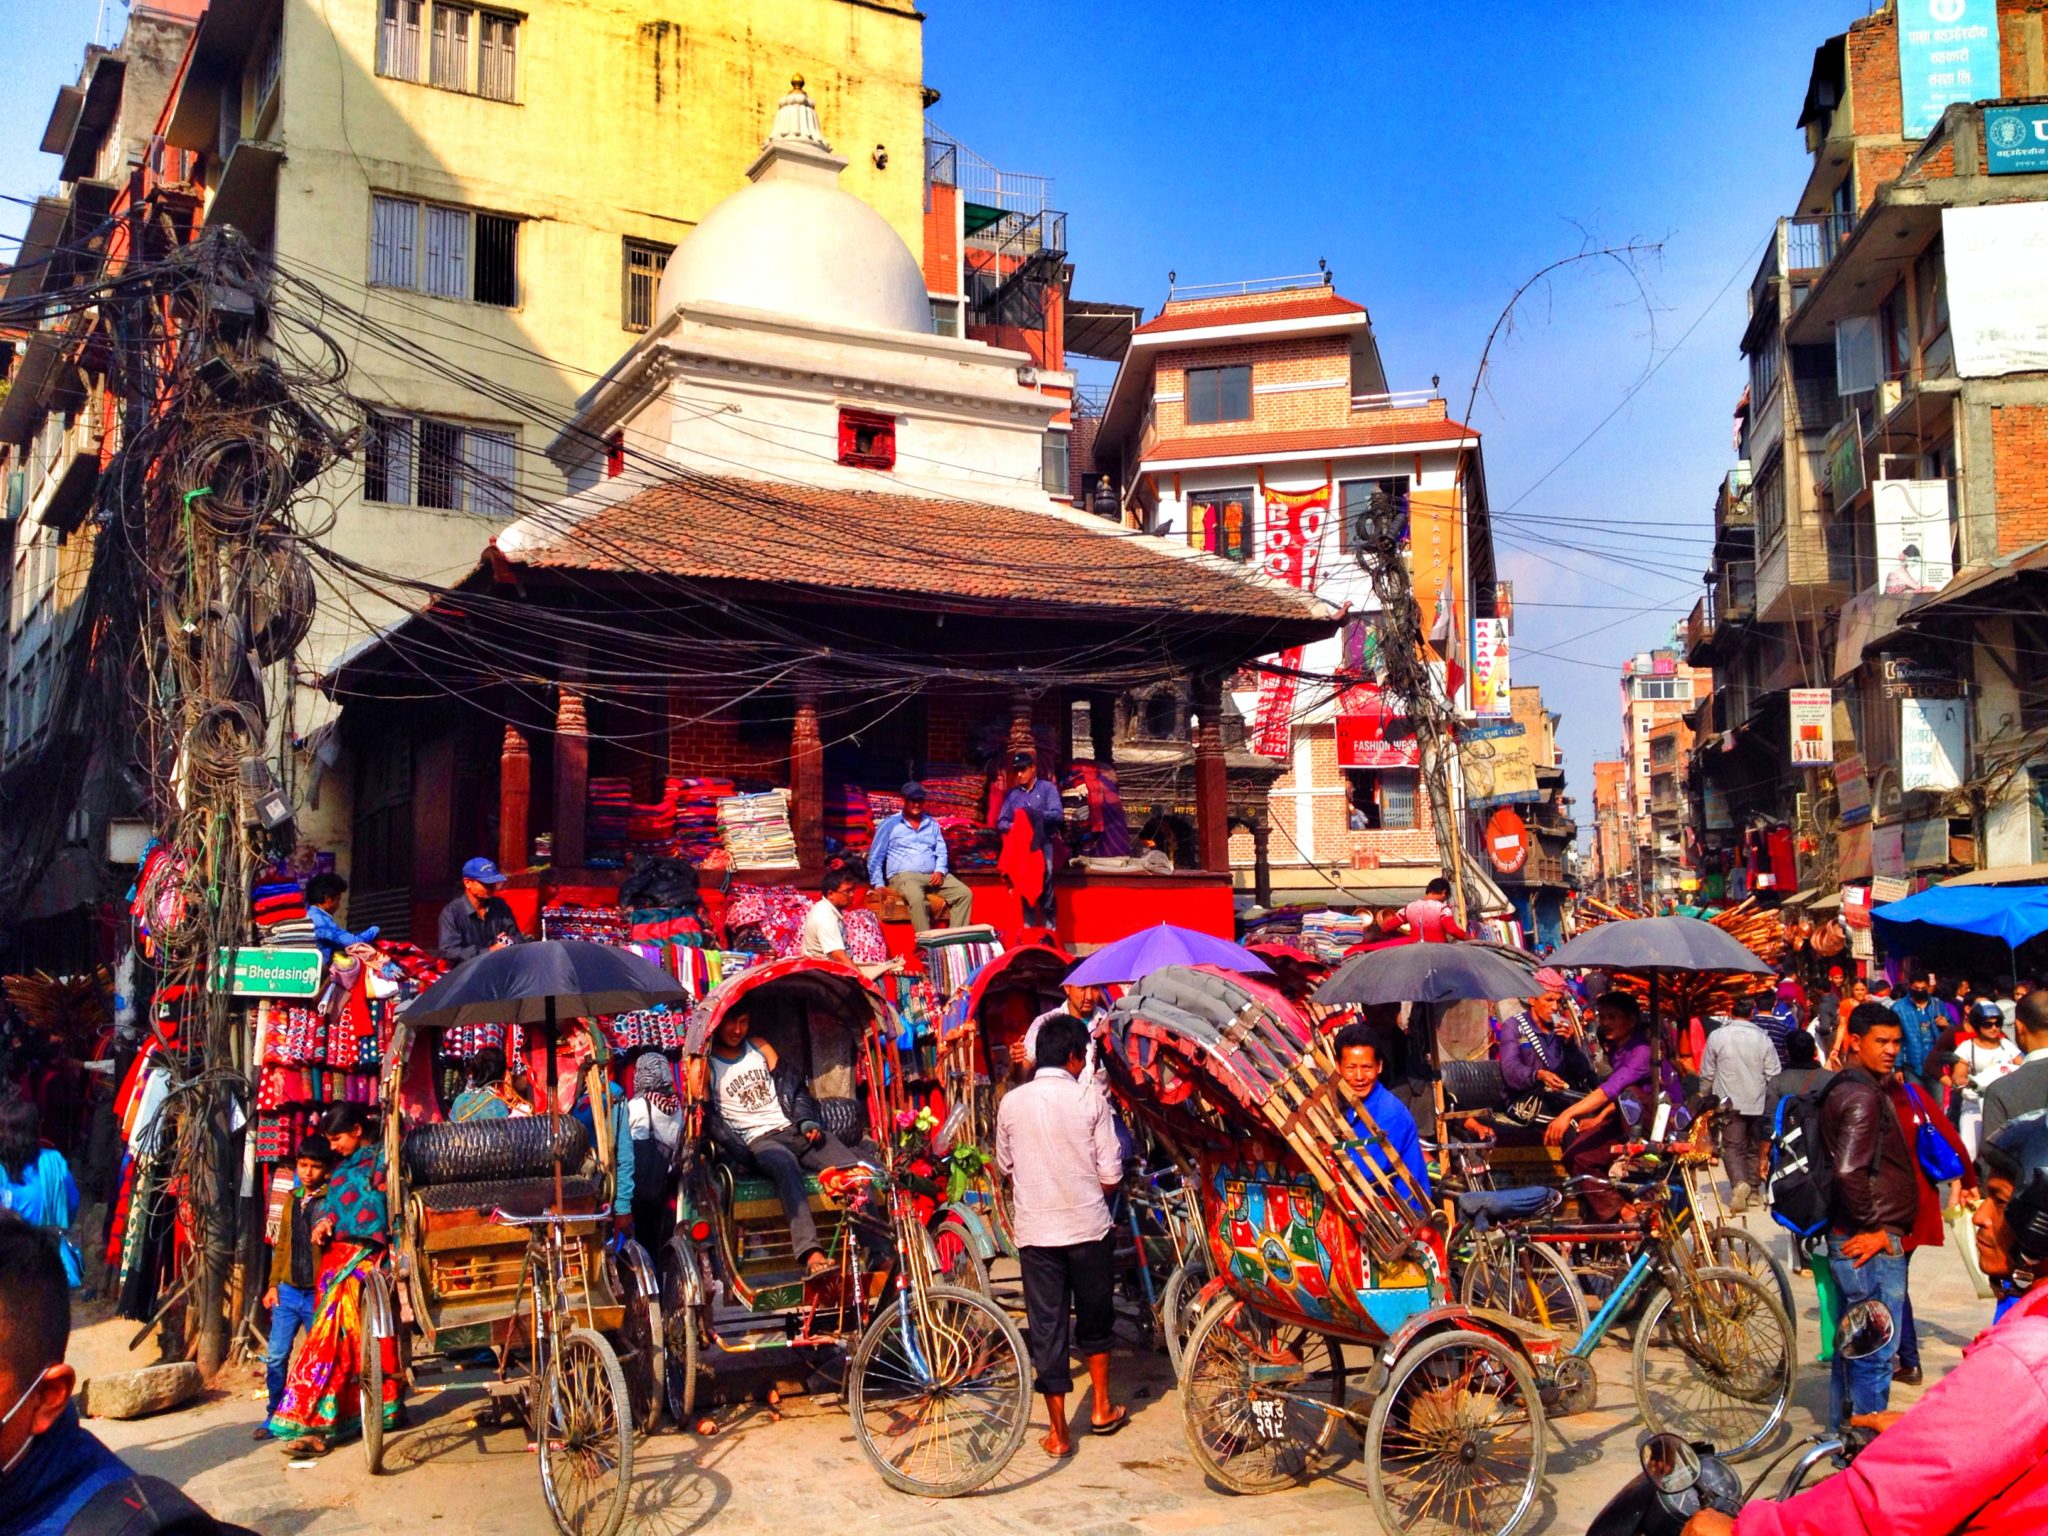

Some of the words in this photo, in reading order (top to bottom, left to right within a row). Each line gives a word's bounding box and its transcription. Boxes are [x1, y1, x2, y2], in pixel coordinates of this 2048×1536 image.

[1432, 513, 1442, 568] SAMAR
[1476, 621, 1491, 697] RAJAMATI
[1353, 740, 1391, 751] FASHION
